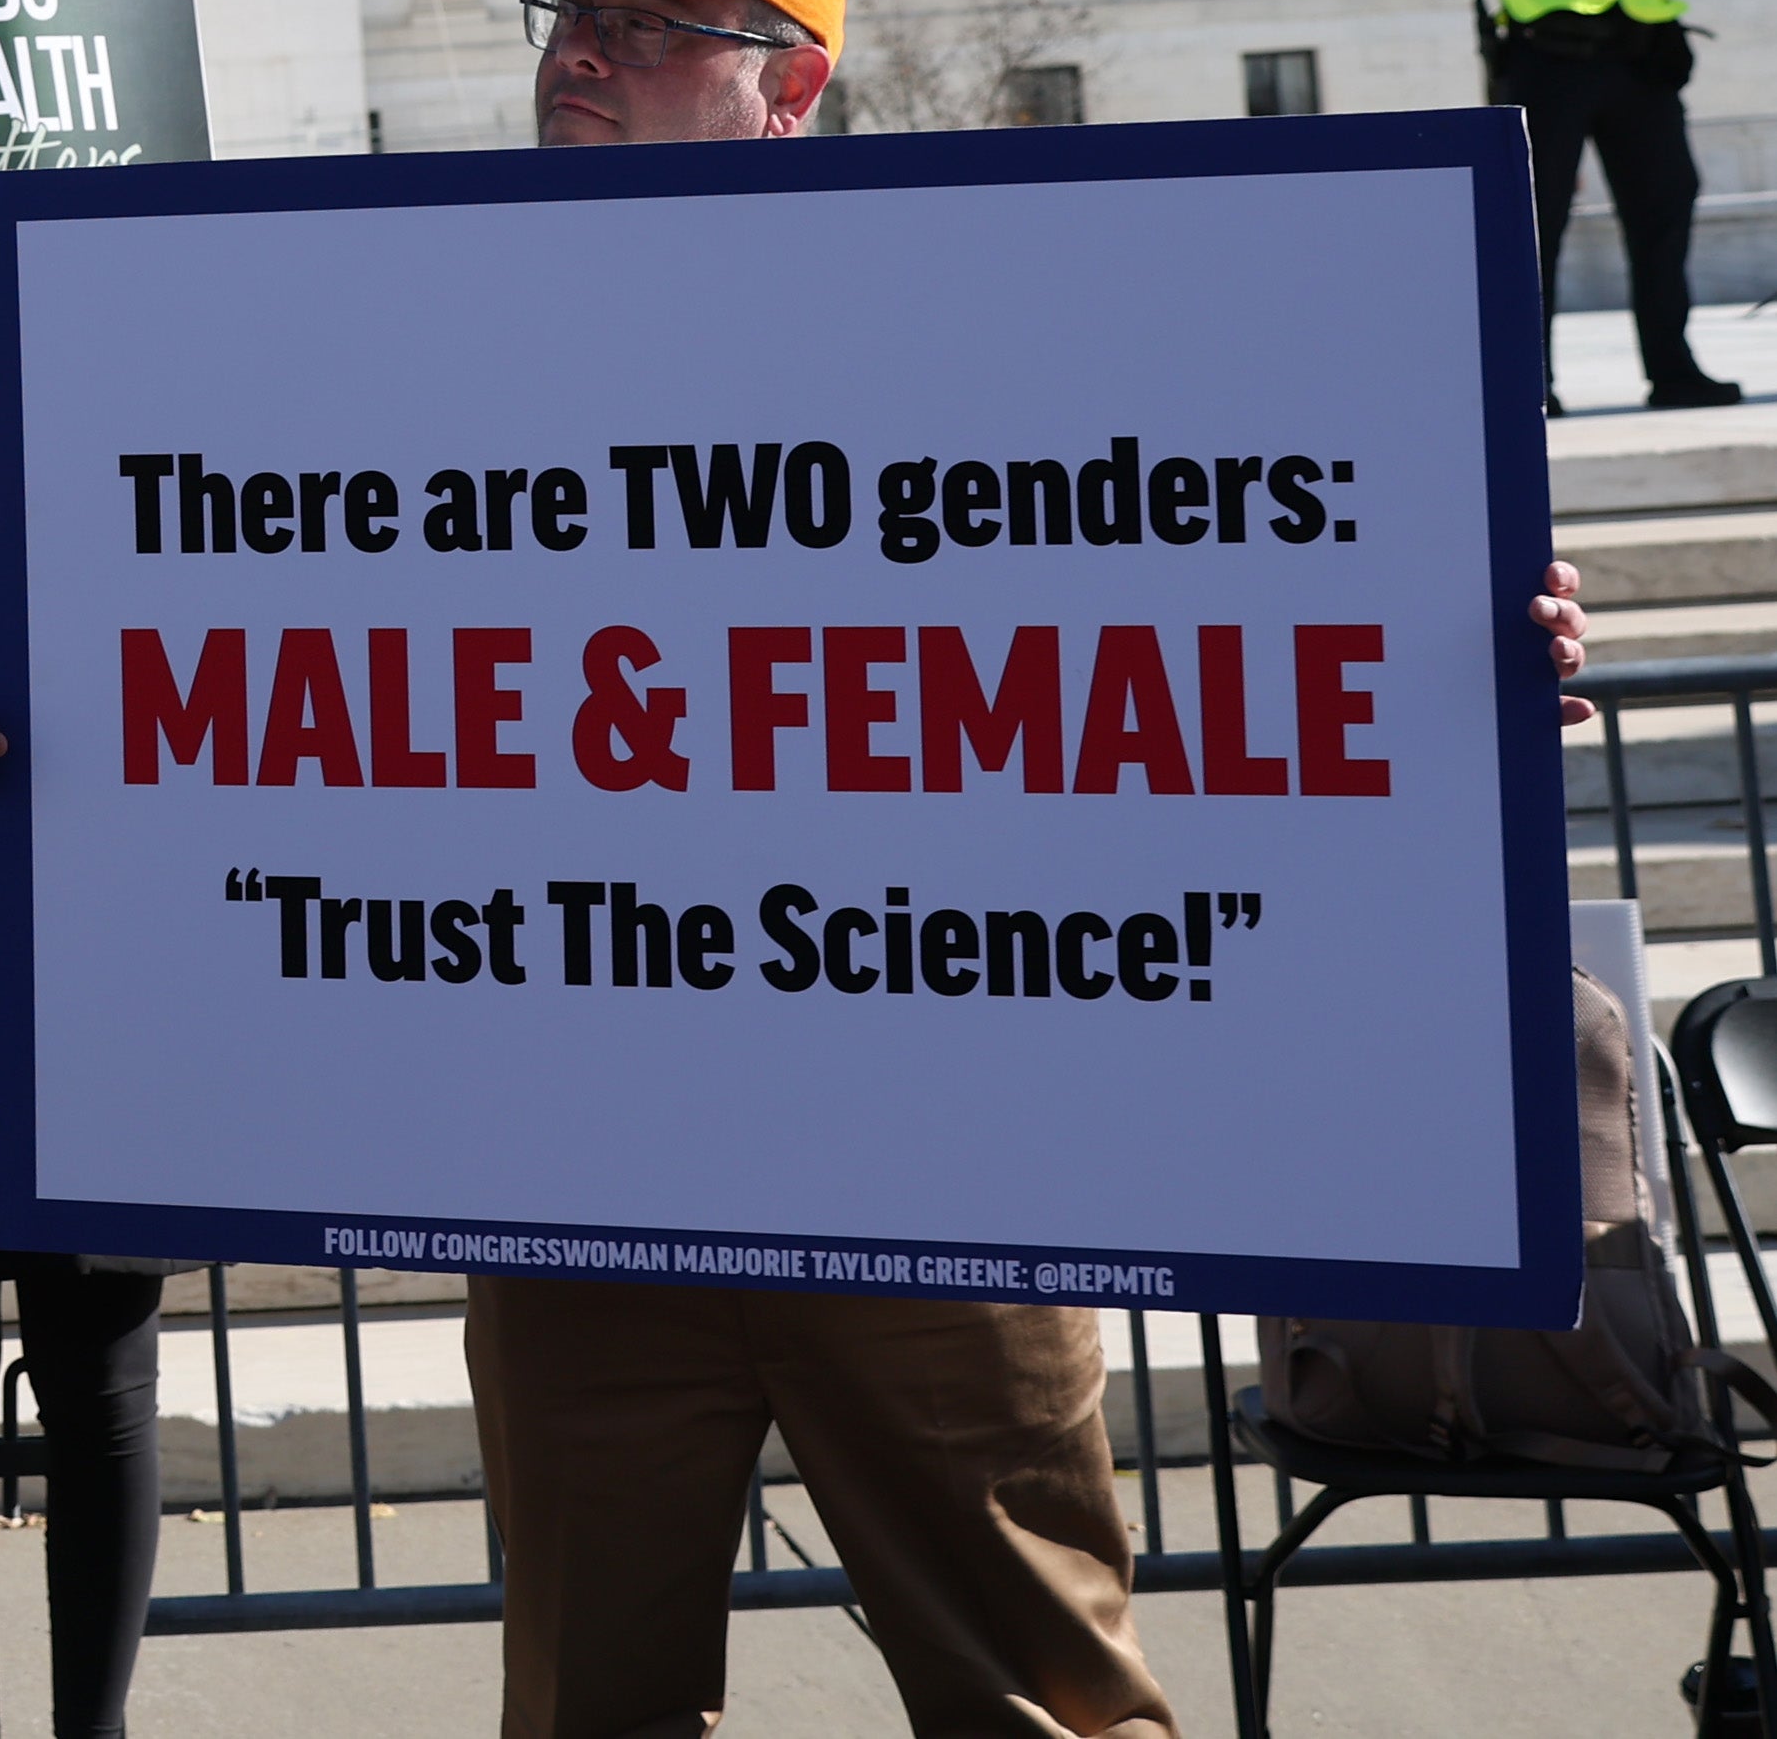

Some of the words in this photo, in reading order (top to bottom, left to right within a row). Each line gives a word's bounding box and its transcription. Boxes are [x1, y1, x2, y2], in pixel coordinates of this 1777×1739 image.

[120, 451, 400, 555] There
[422, 469, 589, 554] are
[608, 440, 852, 551] TWO
[877, 435, 1357, 565] genders:
[120, 626, 537, 790] MALE
[571, 623, 691, 794] &
[727, 623, 1392, 798] FEMALE
[223, 867, 526, 986] “Trust
[547, 880, 735, 992] The
[758, 884, 1262, 1002] Science!”
[324, 1227, 427, 1260] FOLLOW
[431, 1231, 669, 1271] CONGRESSWOMAN
[673, 1244, 806, 1279] MARJORIE
[811, 1250, 912, 1284] TAYLOR
[917, 1255, 1029, 1290] GREENE:
[1033, 1262, 1175, 1297] @REPMTG
